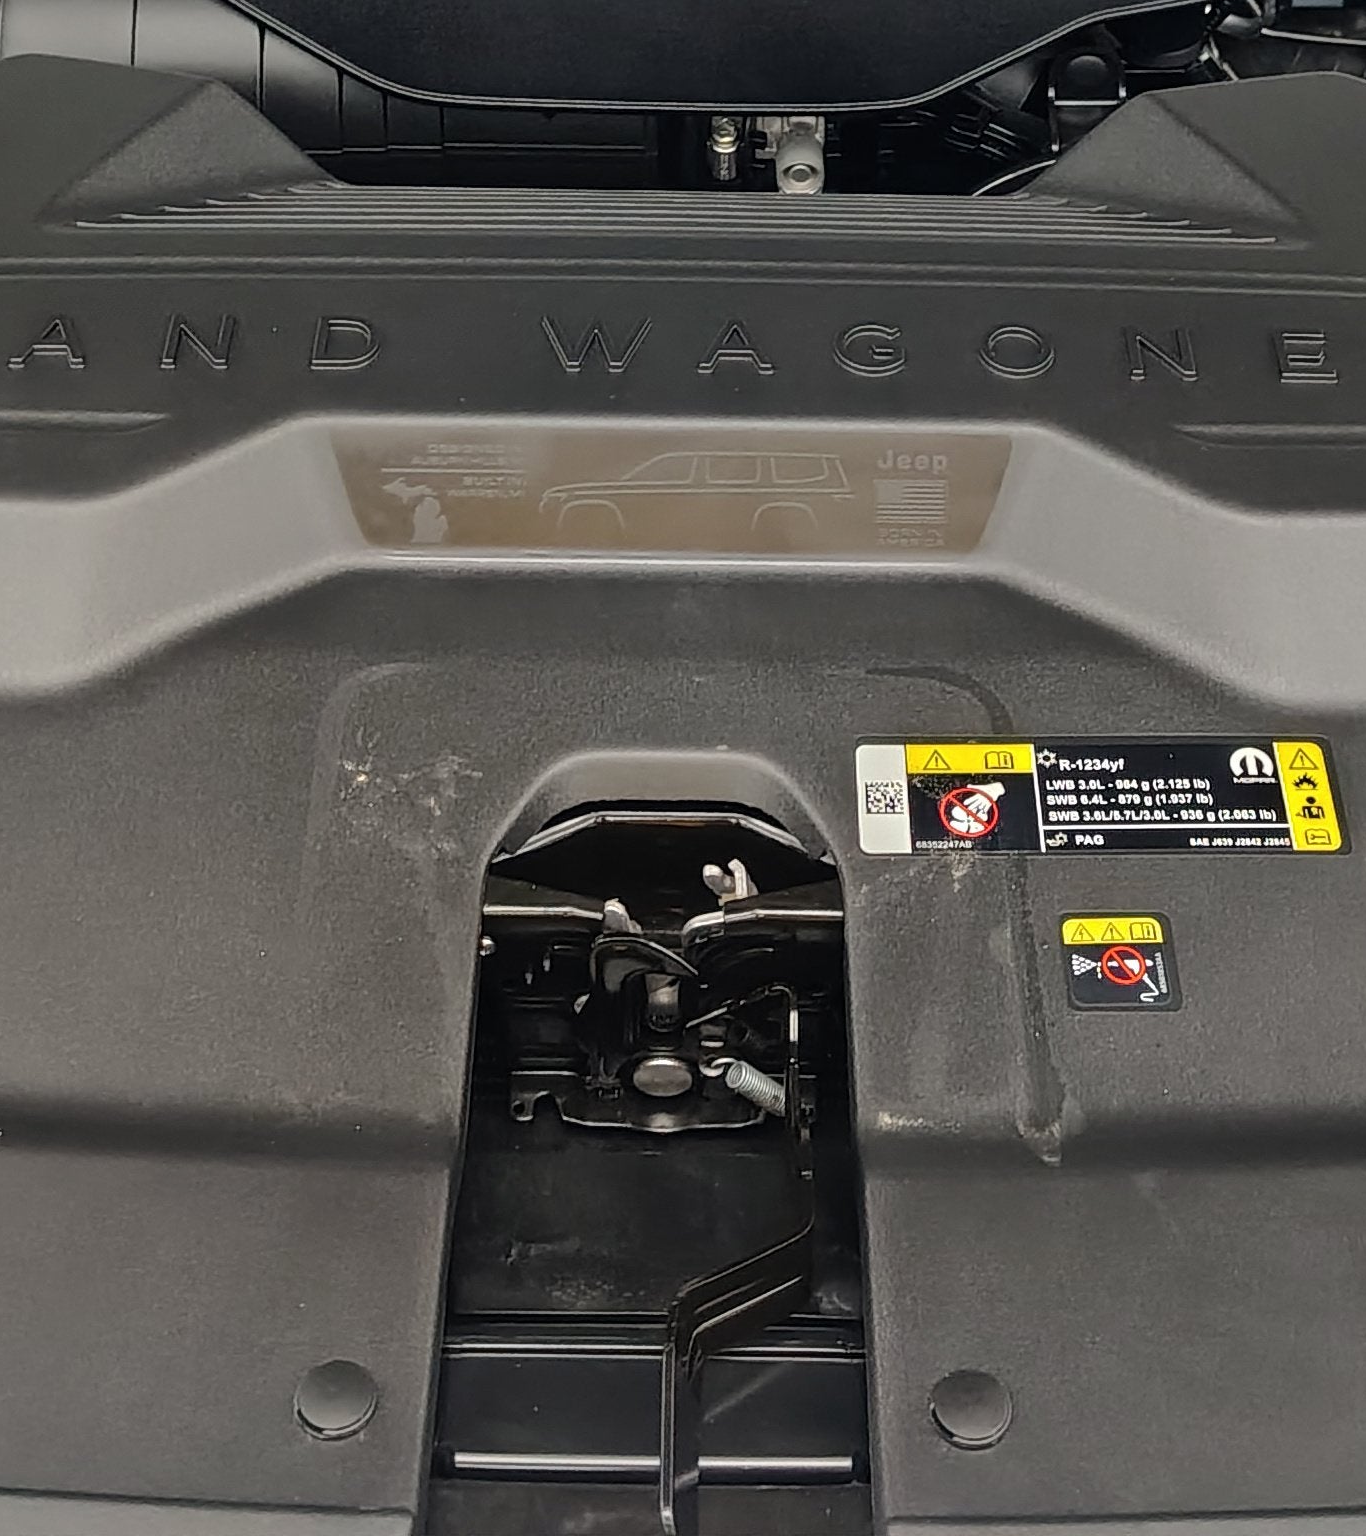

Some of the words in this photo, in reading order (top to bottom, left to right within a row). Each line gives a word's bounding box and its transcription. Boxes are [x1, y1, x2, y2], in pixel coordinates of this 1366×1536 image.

[877, 449, 947, 475] Jeep
[1059, 758, 1125, 773] R-1234yf
[1045, 779, 1075, 790] LWB
[1078, 779, 1105, 790] 3.0L
[1141, 781, 1150, 791] g
[1152, 778, 1190, 791] (2.125
[1193, 778, 1210, 791] lb)
[1046, 794, 1077, 805] SWB
[1080, 794, 1108, 805] 6.4L
[1143, 796, 1153, 806] g
[1195, 794, 1213, 806] lb)
[1048, 810, 1080, 822] SWB
[1207, 811, 1216, 822] g
[1259, 809, 1277, 822] lb)
[1074, 834, 1105, 846] PAG
